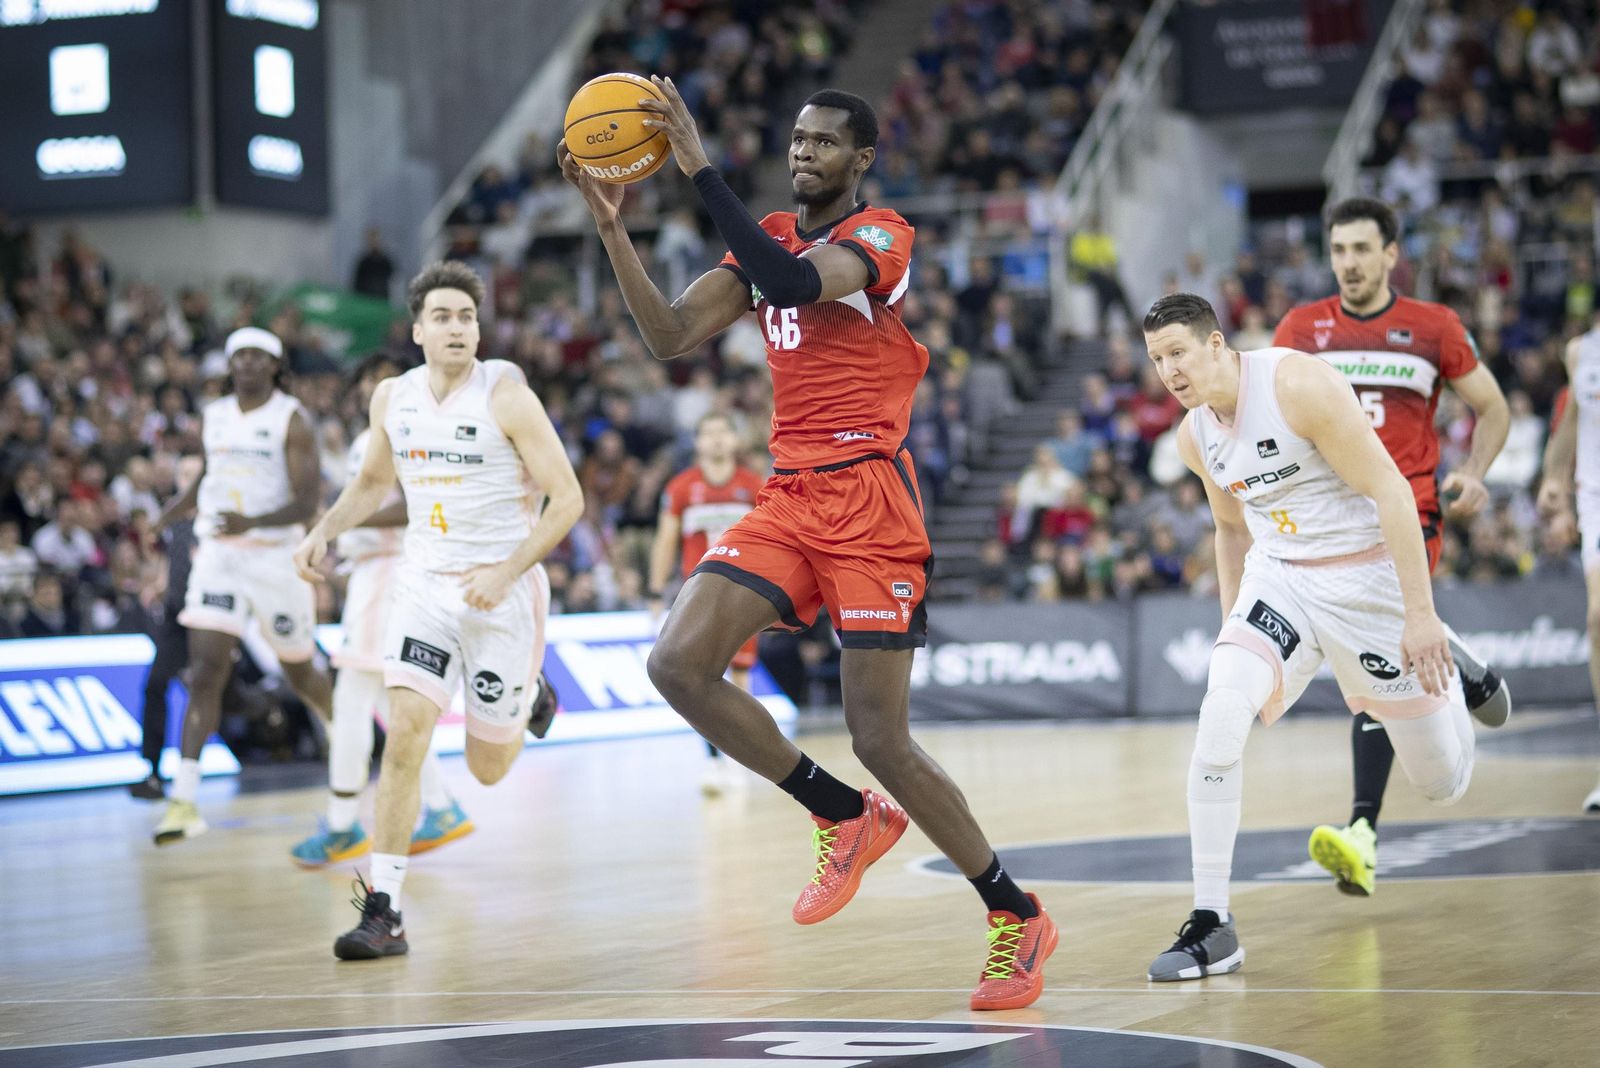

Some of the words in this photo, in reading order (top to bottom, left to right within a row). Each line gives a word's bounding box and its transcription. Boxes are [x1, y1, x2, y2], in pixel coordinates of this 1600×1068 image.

[586, 130, 615, 145] acb
[582, 153, 656, 179] Wilson
[765, 305, 801, 350] 46
[430, 503, 449, 535] 4
[895, 587, 910, 595] acb
[845, 609, 897, 620] BERNER
[1259, 610, 1292, 649] PONS
